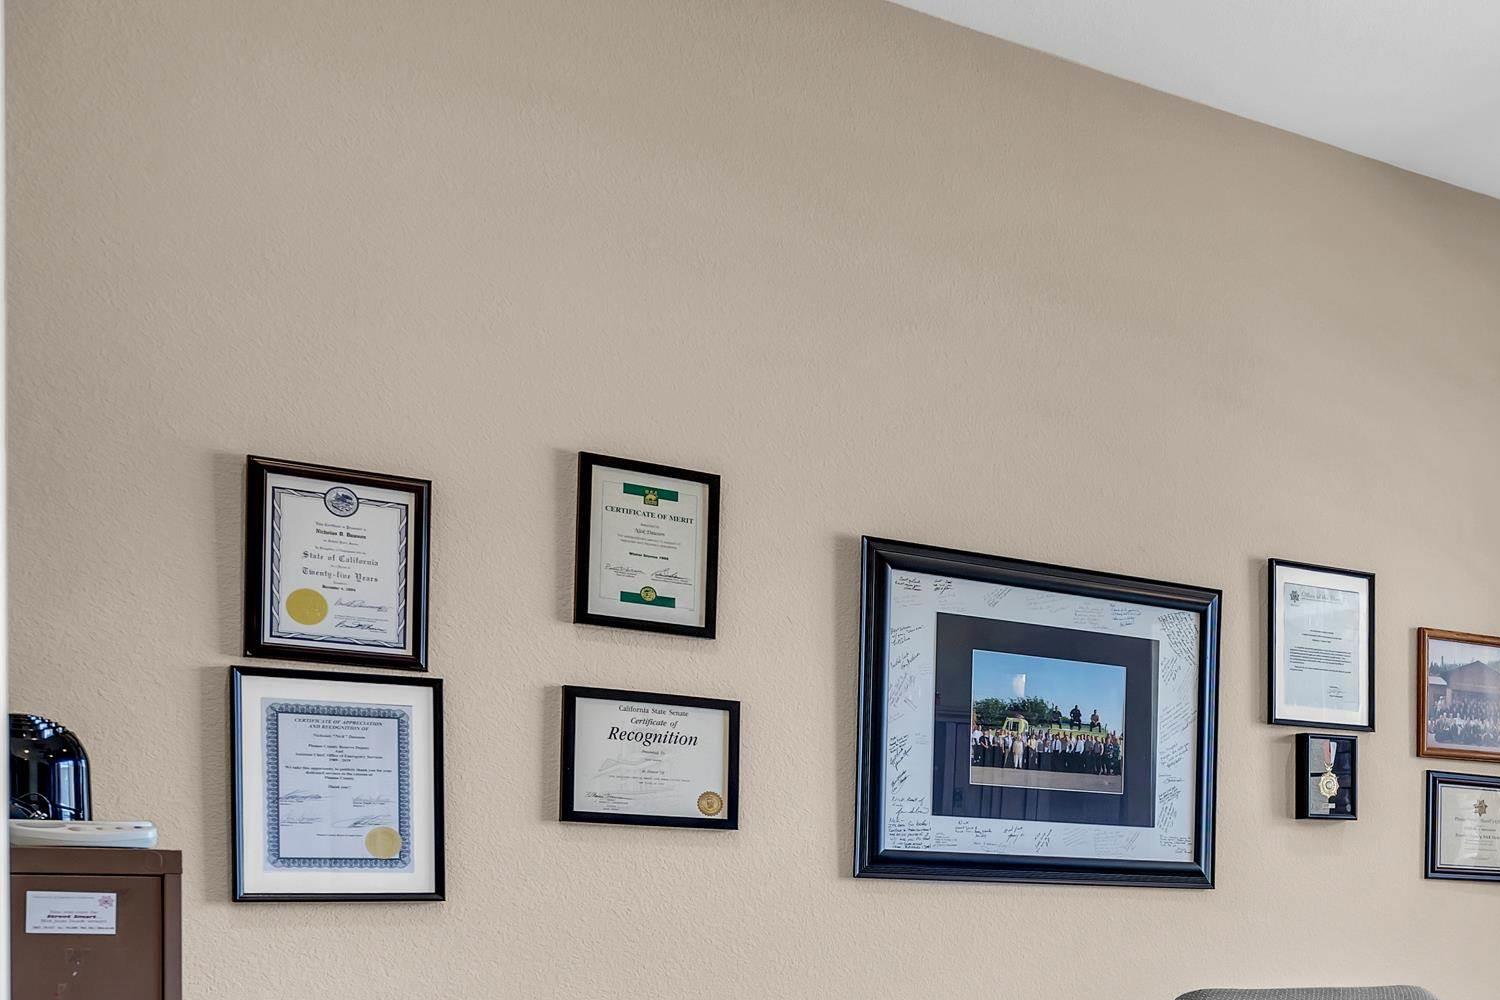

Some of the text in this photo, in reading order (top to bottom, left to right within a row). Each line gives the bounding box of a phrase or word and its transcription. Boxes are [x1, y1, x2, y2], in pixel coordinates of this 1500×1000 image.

[604, 504, 695, 525] CERTIFICATE OF MERIT
[302, 550, 324, 561] State
[327, 553, 336, 562] of
[338, 555, 380, 567] California
[354, 572, 379, 583] Years
[618, 704, 689, 718] California State Senate
[630, 716, 680, 730] Certificate of
[607, 725, 699, 747] Recognition
